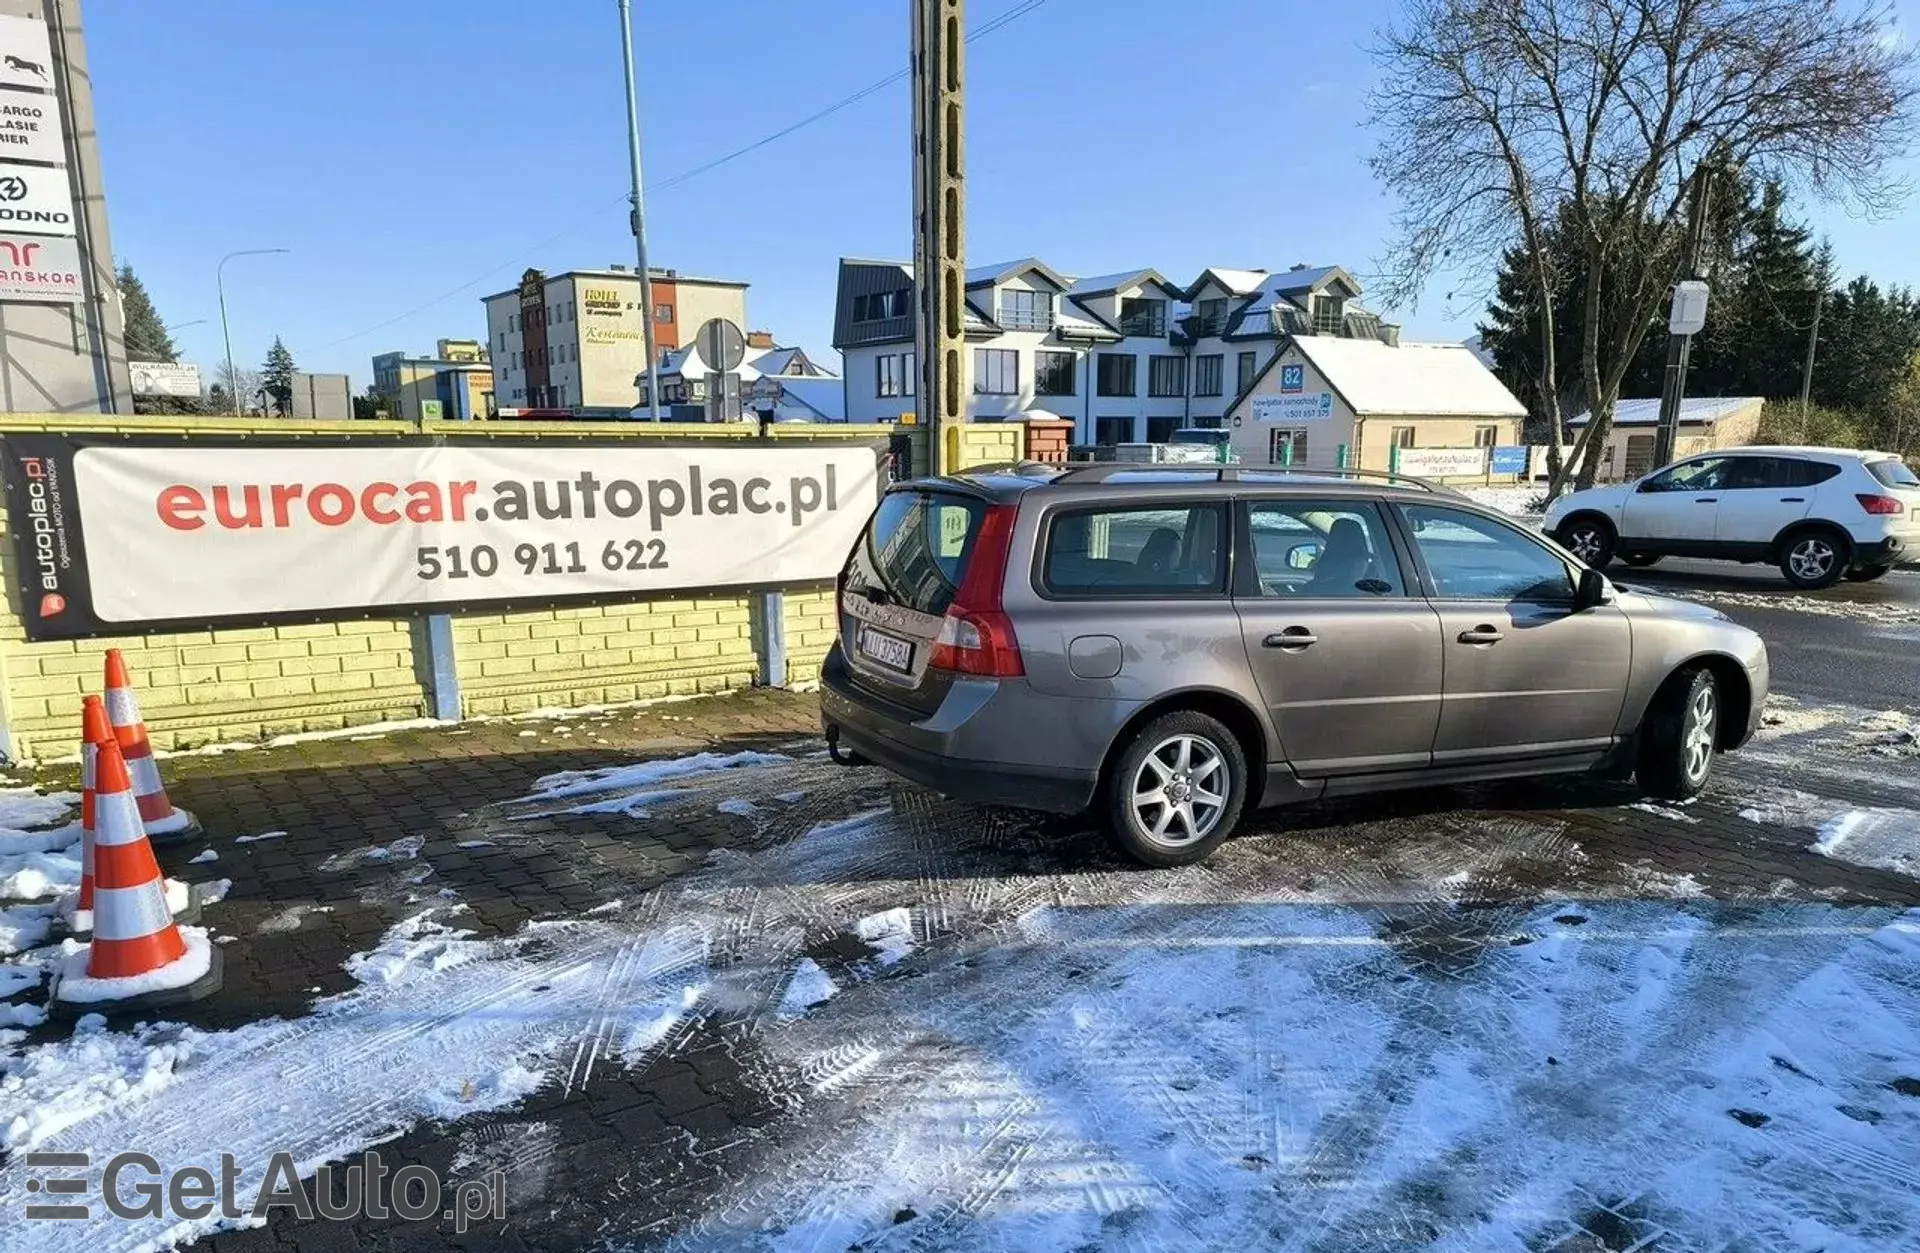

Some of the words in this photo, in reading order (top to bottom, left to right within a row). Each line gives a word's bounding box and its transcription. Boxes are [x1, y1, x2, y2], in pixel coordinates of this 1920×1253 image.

[0, 105, 42, 117] ARGO
[1284, 367, 1300, 384] 82
[156, 463, 838, 531] eurocar.autoplac.pl
[20, 457, 58, 590] autoplac.pl
[416, 544, 498, 580] 510
[514, 540, 587, 576] 911
[601, 537, 669, 571] 622
